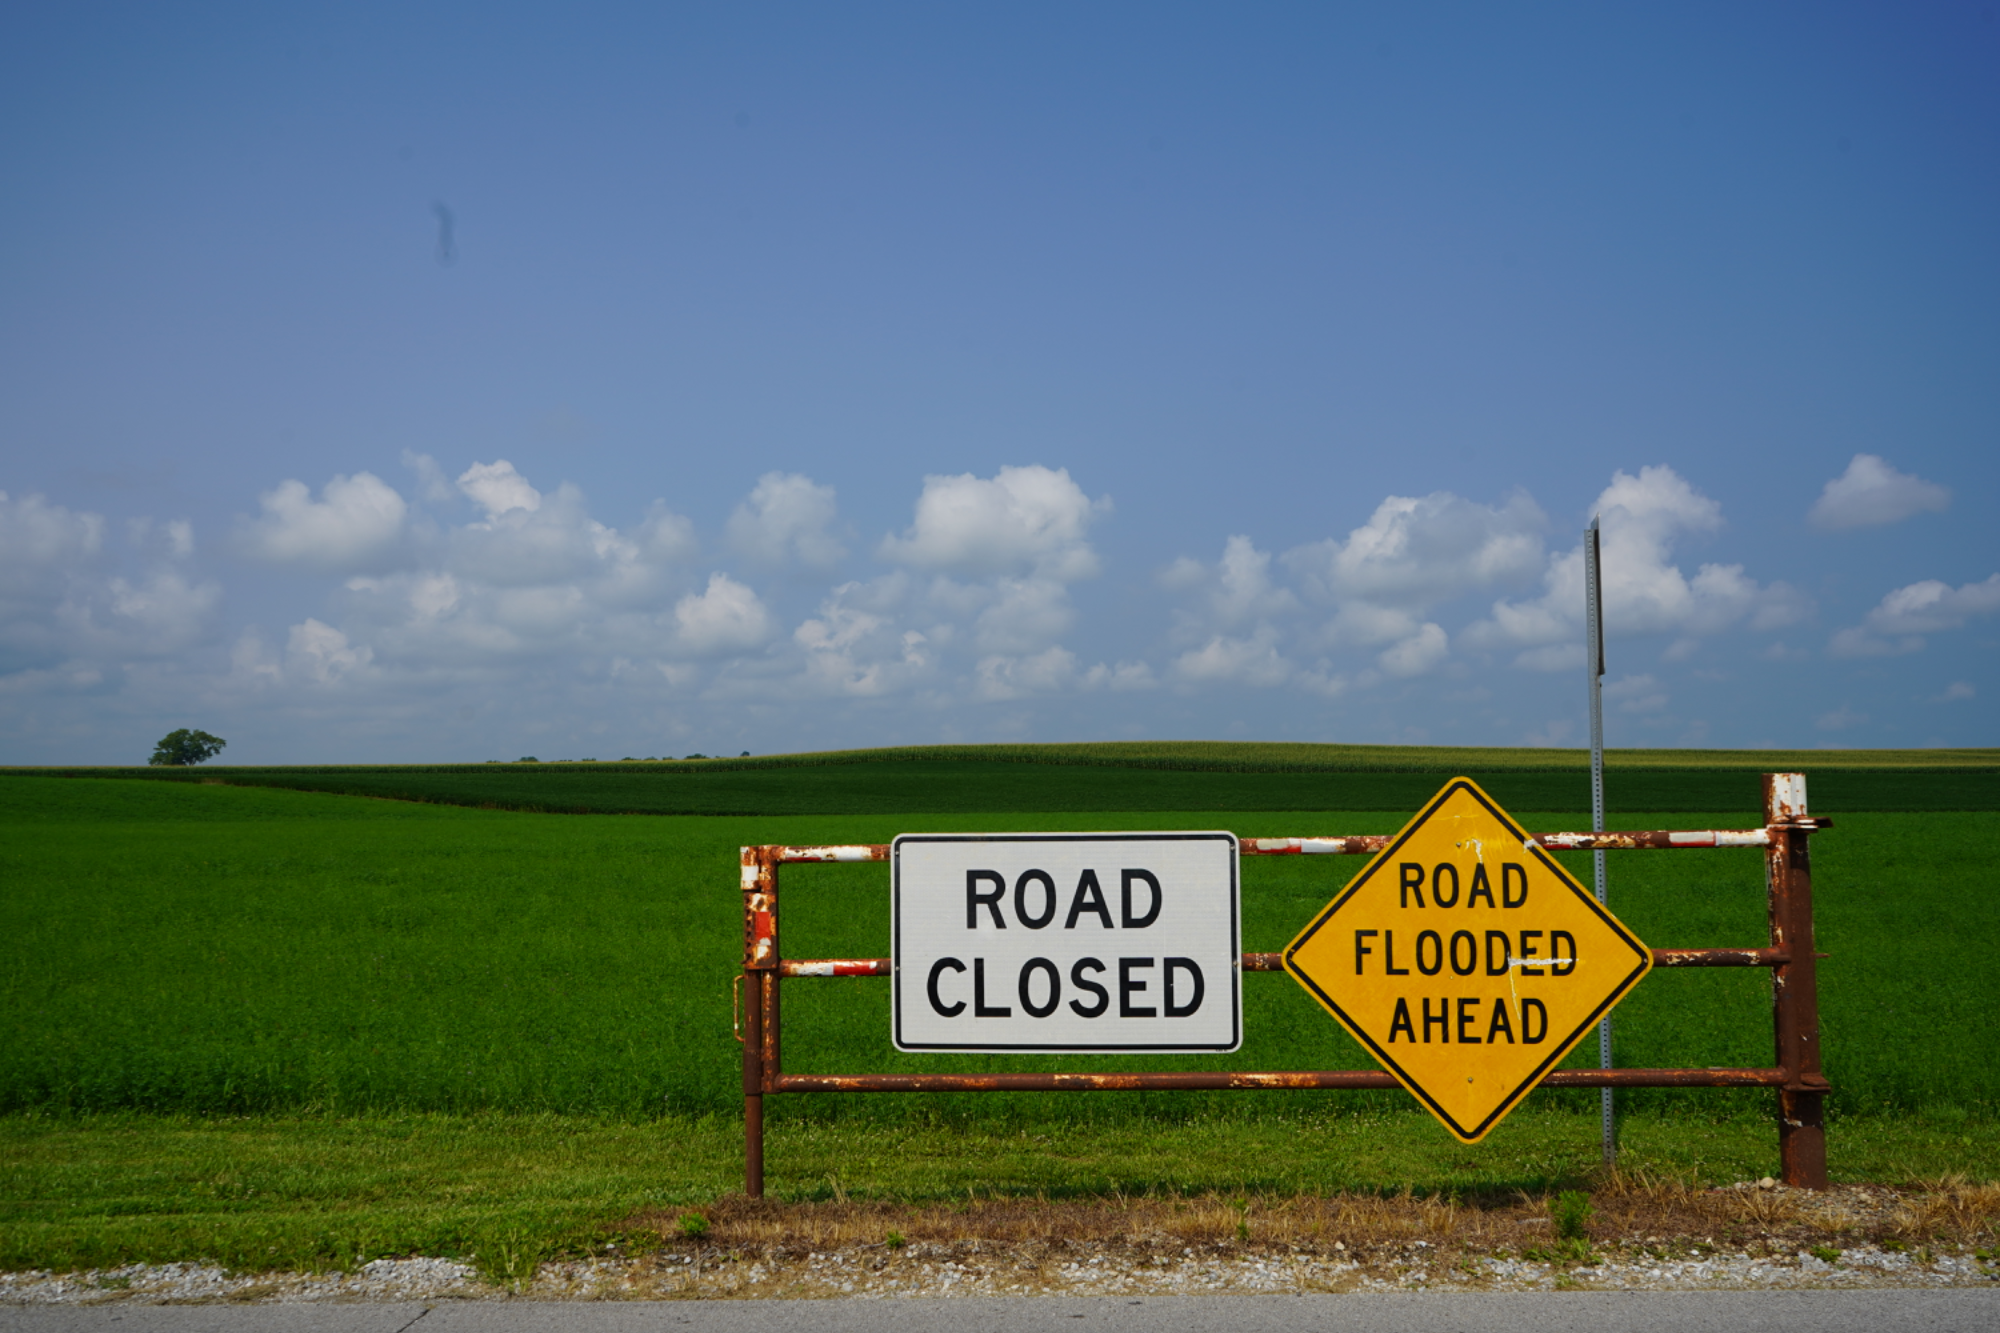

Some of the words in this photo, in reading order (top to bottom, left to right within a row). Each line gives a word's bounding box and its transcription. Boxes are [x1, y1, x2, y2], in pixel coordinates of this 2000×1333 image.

[967, 869, 1162, 929] ROAD
[1400, 863, 1528, 908] ROAD
[1355, 929, 1577, 976] FLOODED
[927, 957, 1204, 1018] CLOSED
[1388, 998, 1548, 1044] AHEAD
